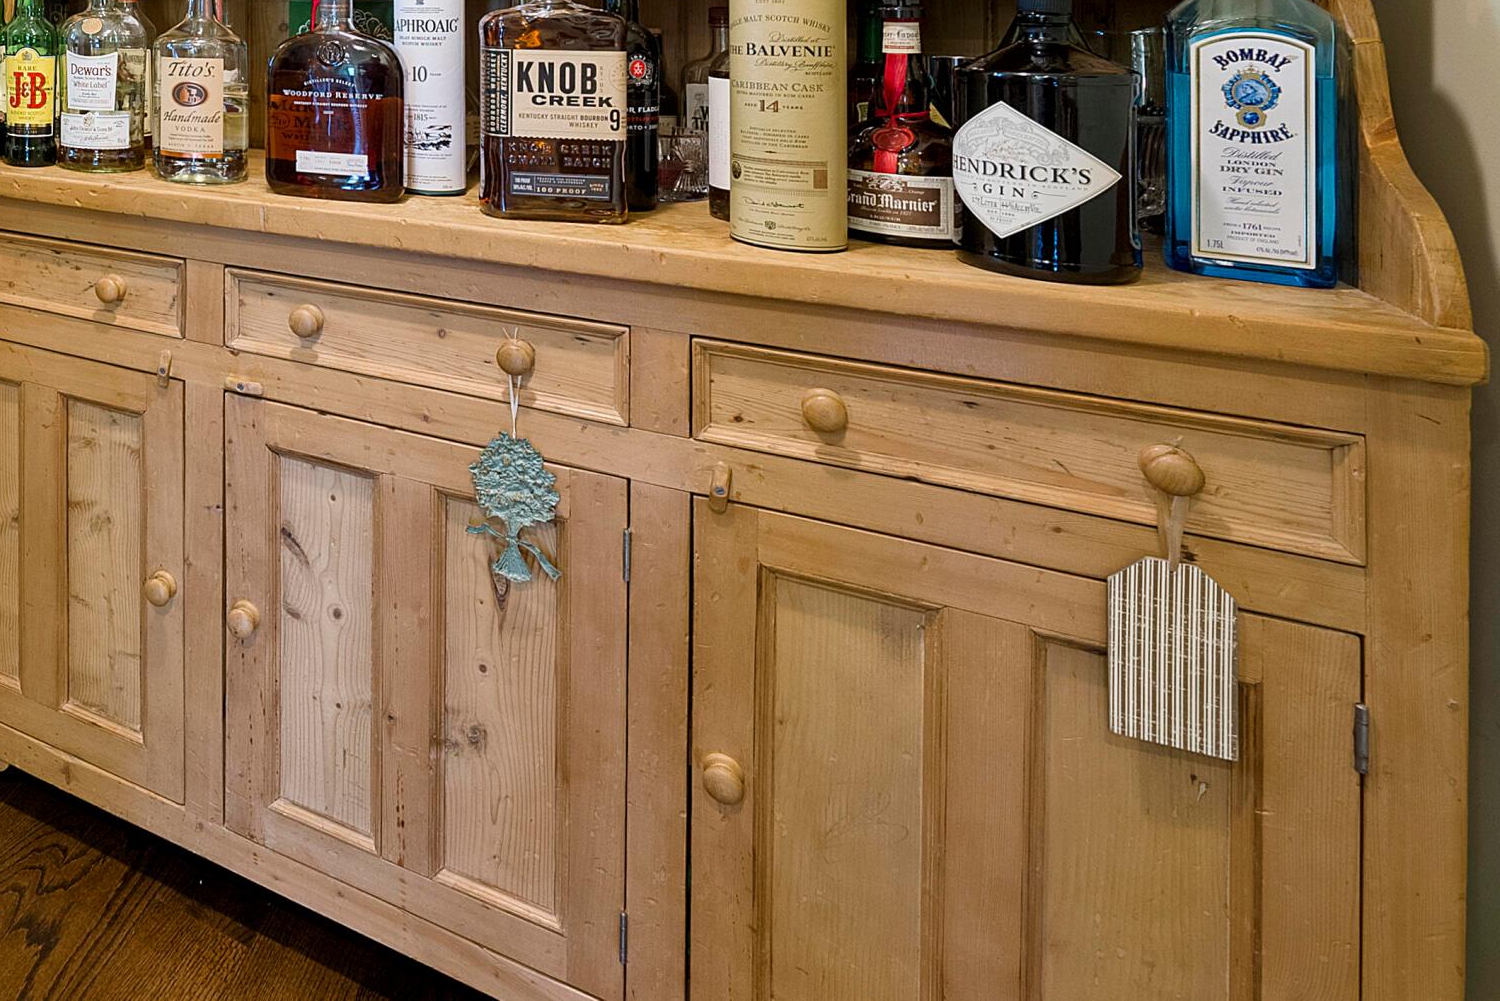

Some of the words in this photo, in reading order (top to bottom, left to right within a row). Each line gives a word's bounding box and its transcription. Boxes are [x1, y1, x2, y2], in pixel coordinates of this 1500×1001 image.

[394, 18, 457, 33] APHROAIG
[743, 15, 763, 23] MALT
[765, 15, 799, 24] SCOTCH
[803, 18, 831, 33] WHISKY
[746, 42, 833, 58] BALVENIE
[1212, 48, 1293, 72] BOMBAY
[70, 63, 112, 77] Dewar's
[168, 61, 215, 78] Tito's
[411, 66, 427, 83] 10
[500, 53, 508, 91] KENTUCKY
[517, 61, 597, 94] KNOB
[9, 71, 48, 110] J&B
[731, 79, 788, 91] CARIBBEAN
[791, 83, 824, 92] CASK
[283, 89, 332, 98] WOODFORD
[336, 90, 382, 100] RESERVE
[531, 95, 613, 108] CREEK
[500, 92, 508, 133] CLERMONT,
[759, 100, 779, 113] 14
[164, 110, 220, 123] Handmade
[609, 110, 621, 132] 9
[1209, 119, 1294, 145] SAPPHIRE
[560, 144, 612, 156] CREEK
[1221, 146, 1283, 161] Distilled
[564, 157, 611, 168] BATCH
[953, 154, 1092, 185] HENDRICK'S
[1227, 159, 1276, 167] LONDON
[1220, 165, 1251, 175] DRY
[1255, 167, 1284, 176] GIN
[1230, 175, 1273, 188] Vapour
[983, 183, 1025, 198] GIN
[1222, 186, 1283, 197] INFUSED
[877, 193, 935, 212] Marnier
[1242, 223, 1262, 231] 1761
[1207, 238, 1224, 249] 1.75L
